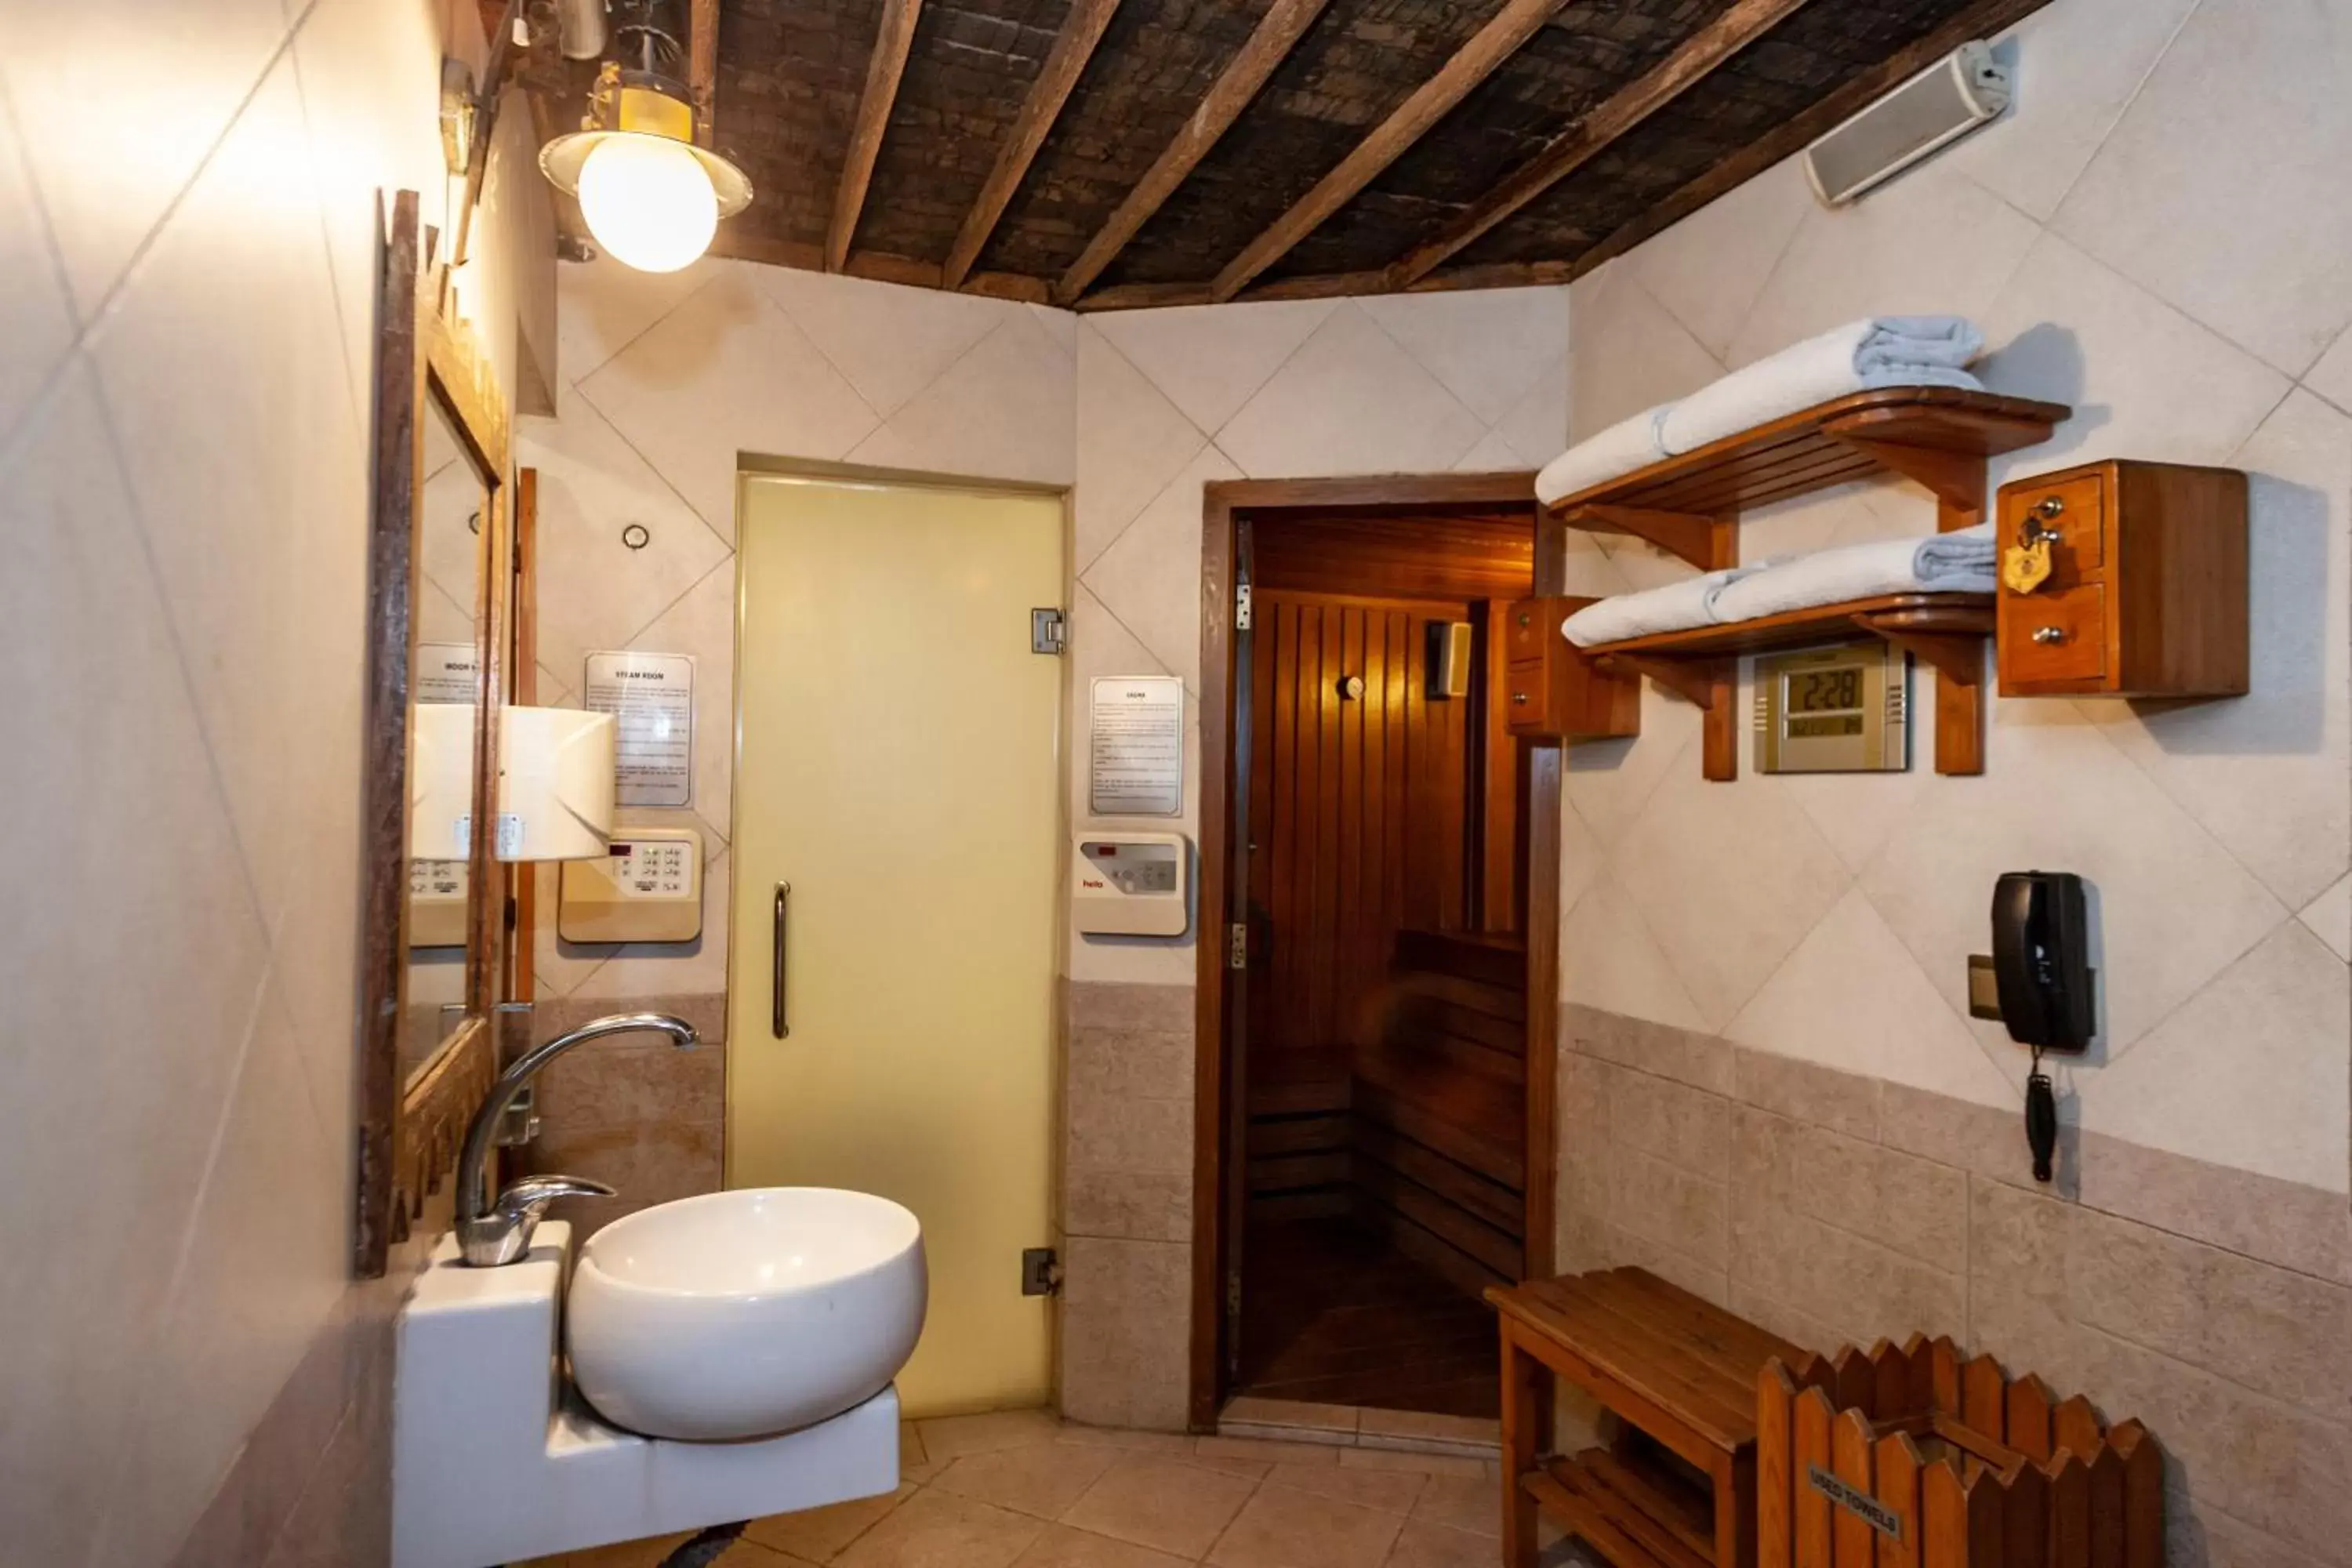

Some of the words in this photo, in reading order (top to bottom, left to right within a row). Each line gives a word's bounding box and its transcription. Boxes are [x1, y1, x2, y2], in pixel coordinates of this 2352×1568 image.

[1803, 670, 1857, 710] 2:28
[1810, 1468, 1842, 1499] USED
[1845, 1489, 1896, 1532] TOWELS
